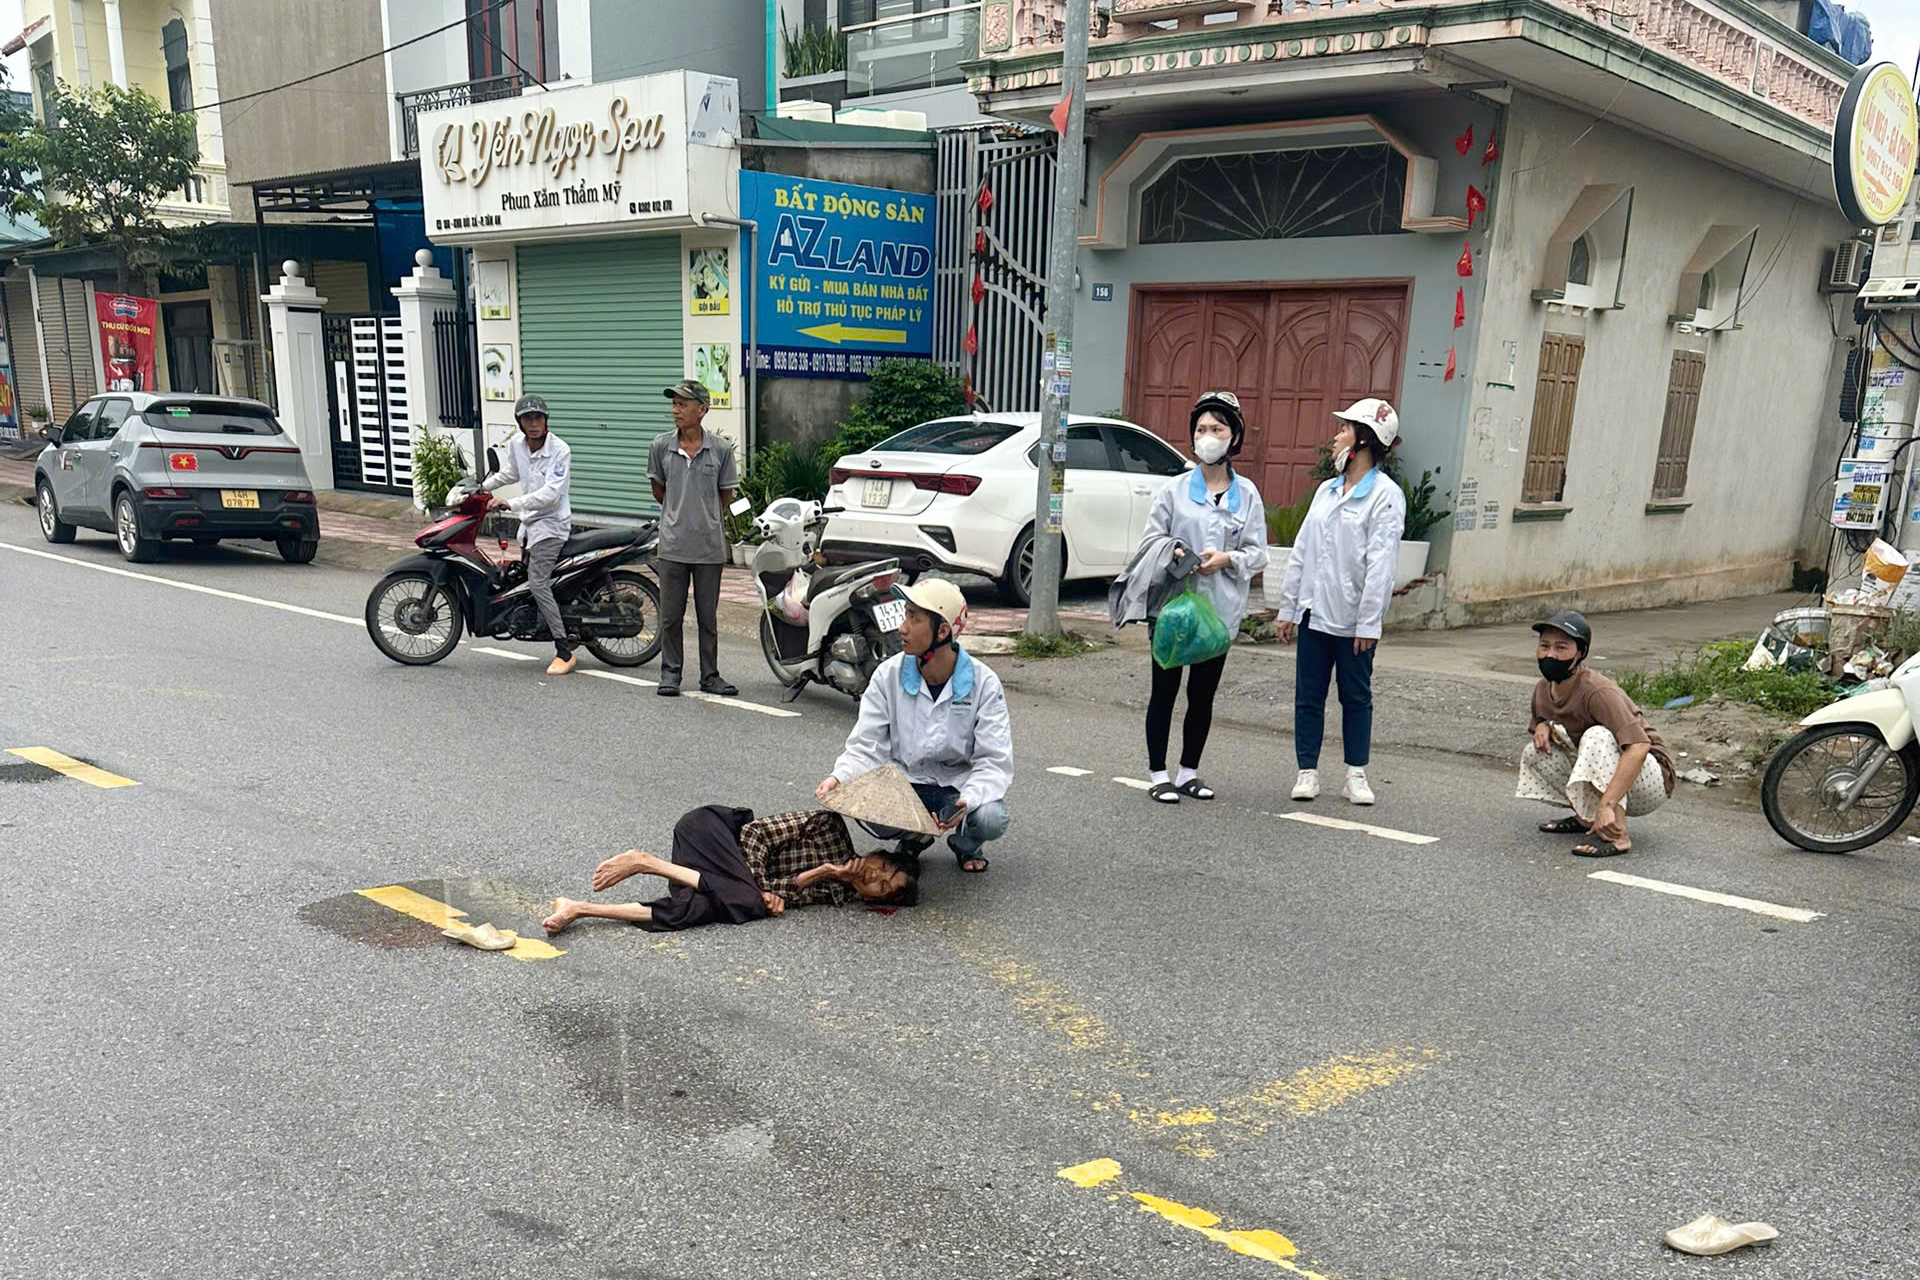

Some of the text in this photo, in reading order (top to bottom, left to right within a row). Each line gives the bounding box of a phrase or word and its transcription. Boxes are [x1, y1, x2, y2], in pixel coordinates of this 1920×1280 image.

[468, 94, 666, 188] Yến Ngọc Spa
[501, 178, 622, 211] Phun Xăm Thẩm Mỹ
[775, 183, 925, 224] BẤT ĐỘNG SẢN
[769, 275, 785, 290] KÝ
[790, 273, 810, 292] GỬI
[823, 280, 849, 296] MUA
[853, 280, 877, 298] BÁN
[881, 282, 904, 300] NHÀ
[907, 283, 929, 301] ĐẤT
[776, 294, 923, 323] HỖ TRỢ THỦ TỤC PHÁP LÝ
[879, 601, 904, 617] 14-X1
